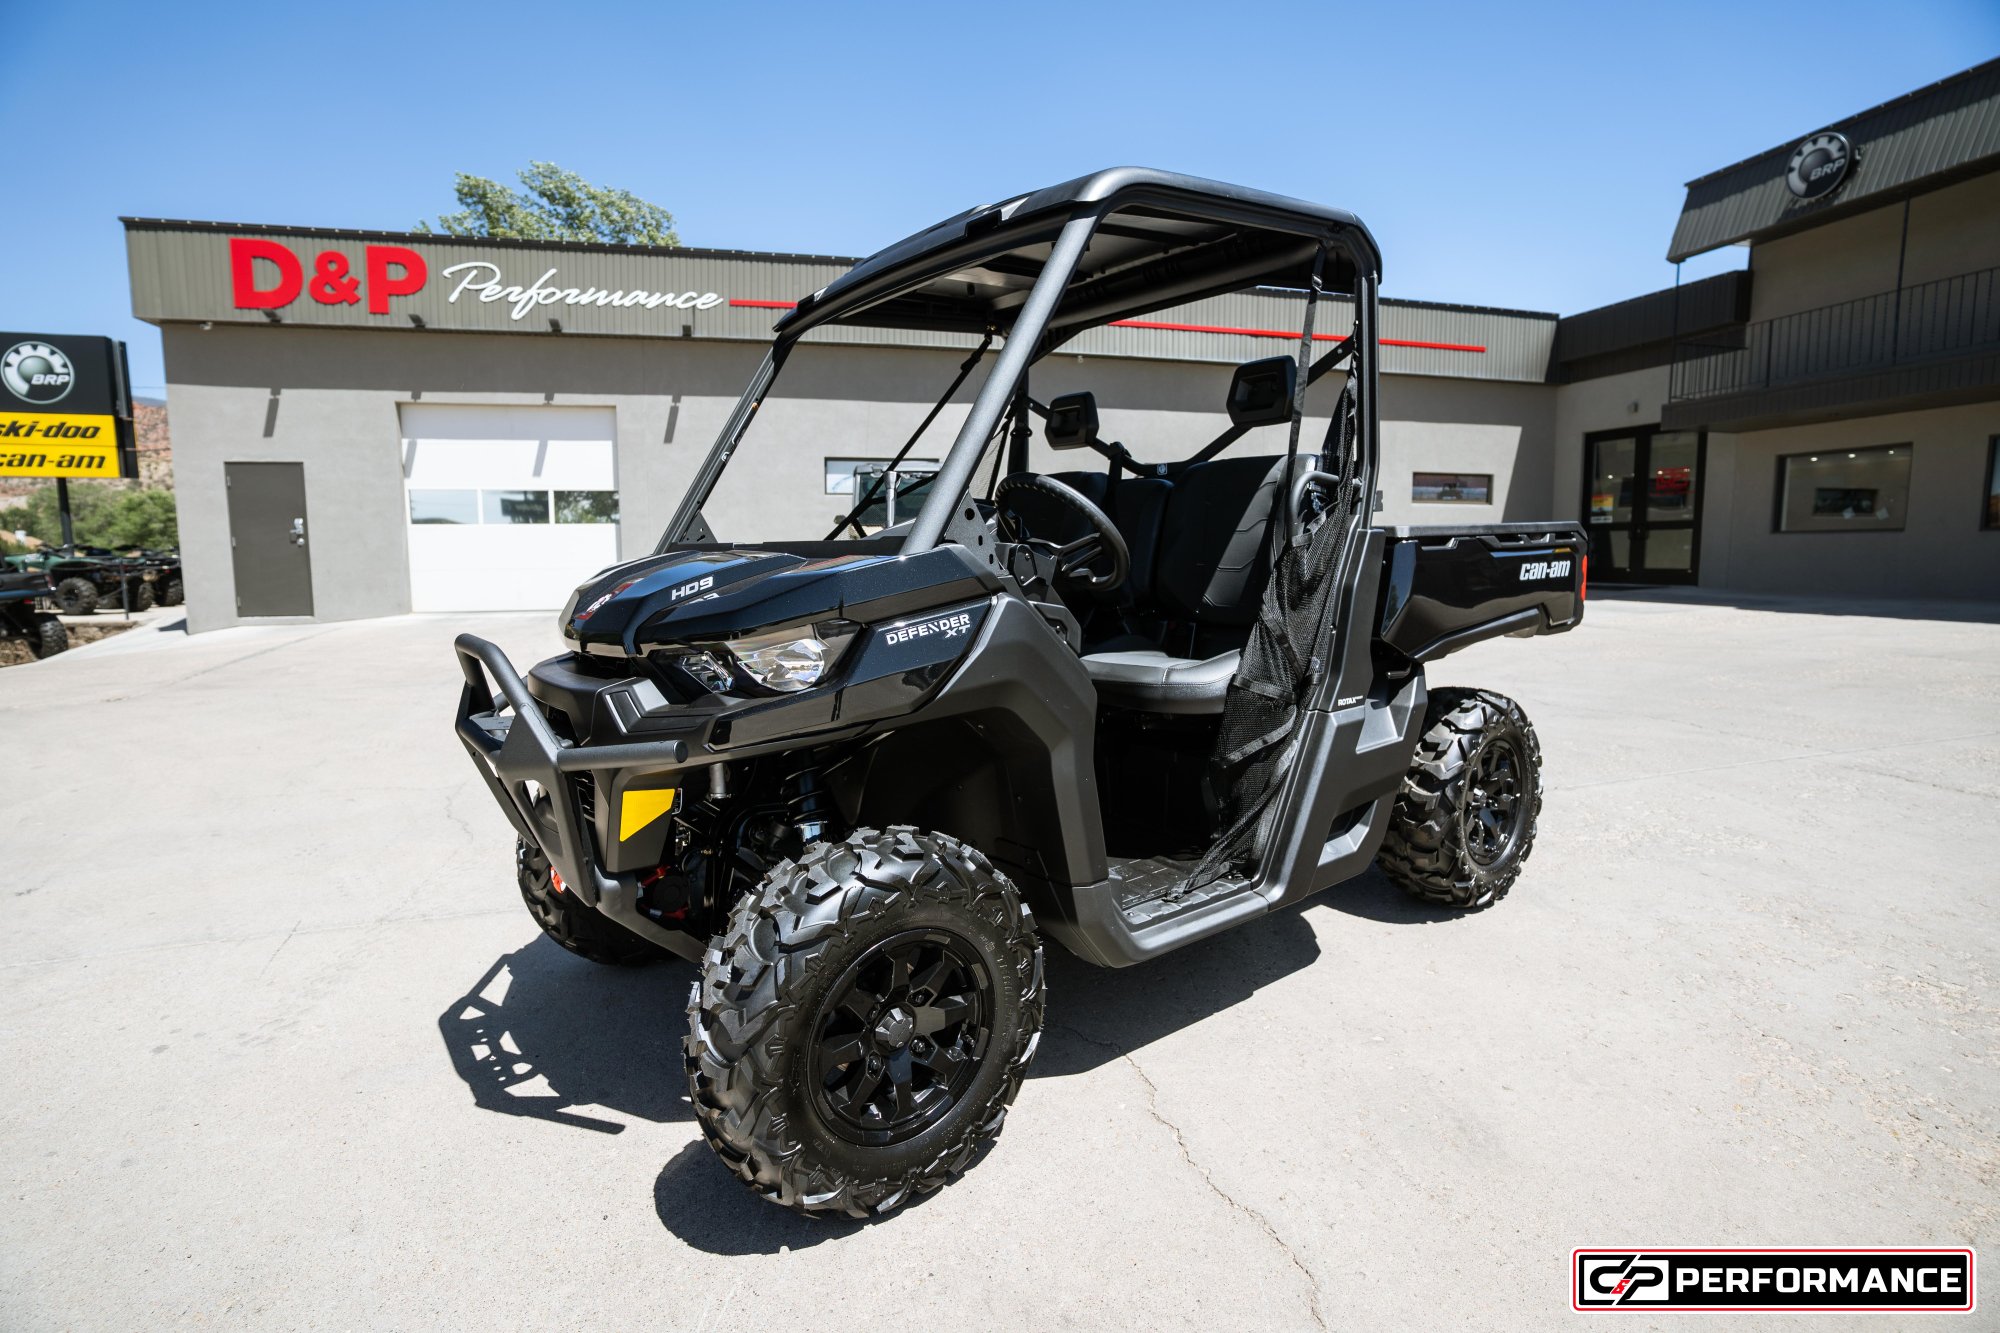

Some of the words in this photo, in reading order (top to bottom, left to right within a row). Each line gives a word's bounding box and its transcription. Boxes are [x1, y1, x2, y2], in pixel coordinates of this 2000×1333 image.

[1809, 158, 1845, 180] BRP
[229, 238, 428, 315] D&P
[442, 261, 724, 320] Performance
[31, 373, 70, 385] BRP
[1519, 560, 1571, 581] can-am
[671, 576, 714, 601] HD9
[886, 613, 970, 646] DEFENDER
[944, 624, 971, 638] XT
